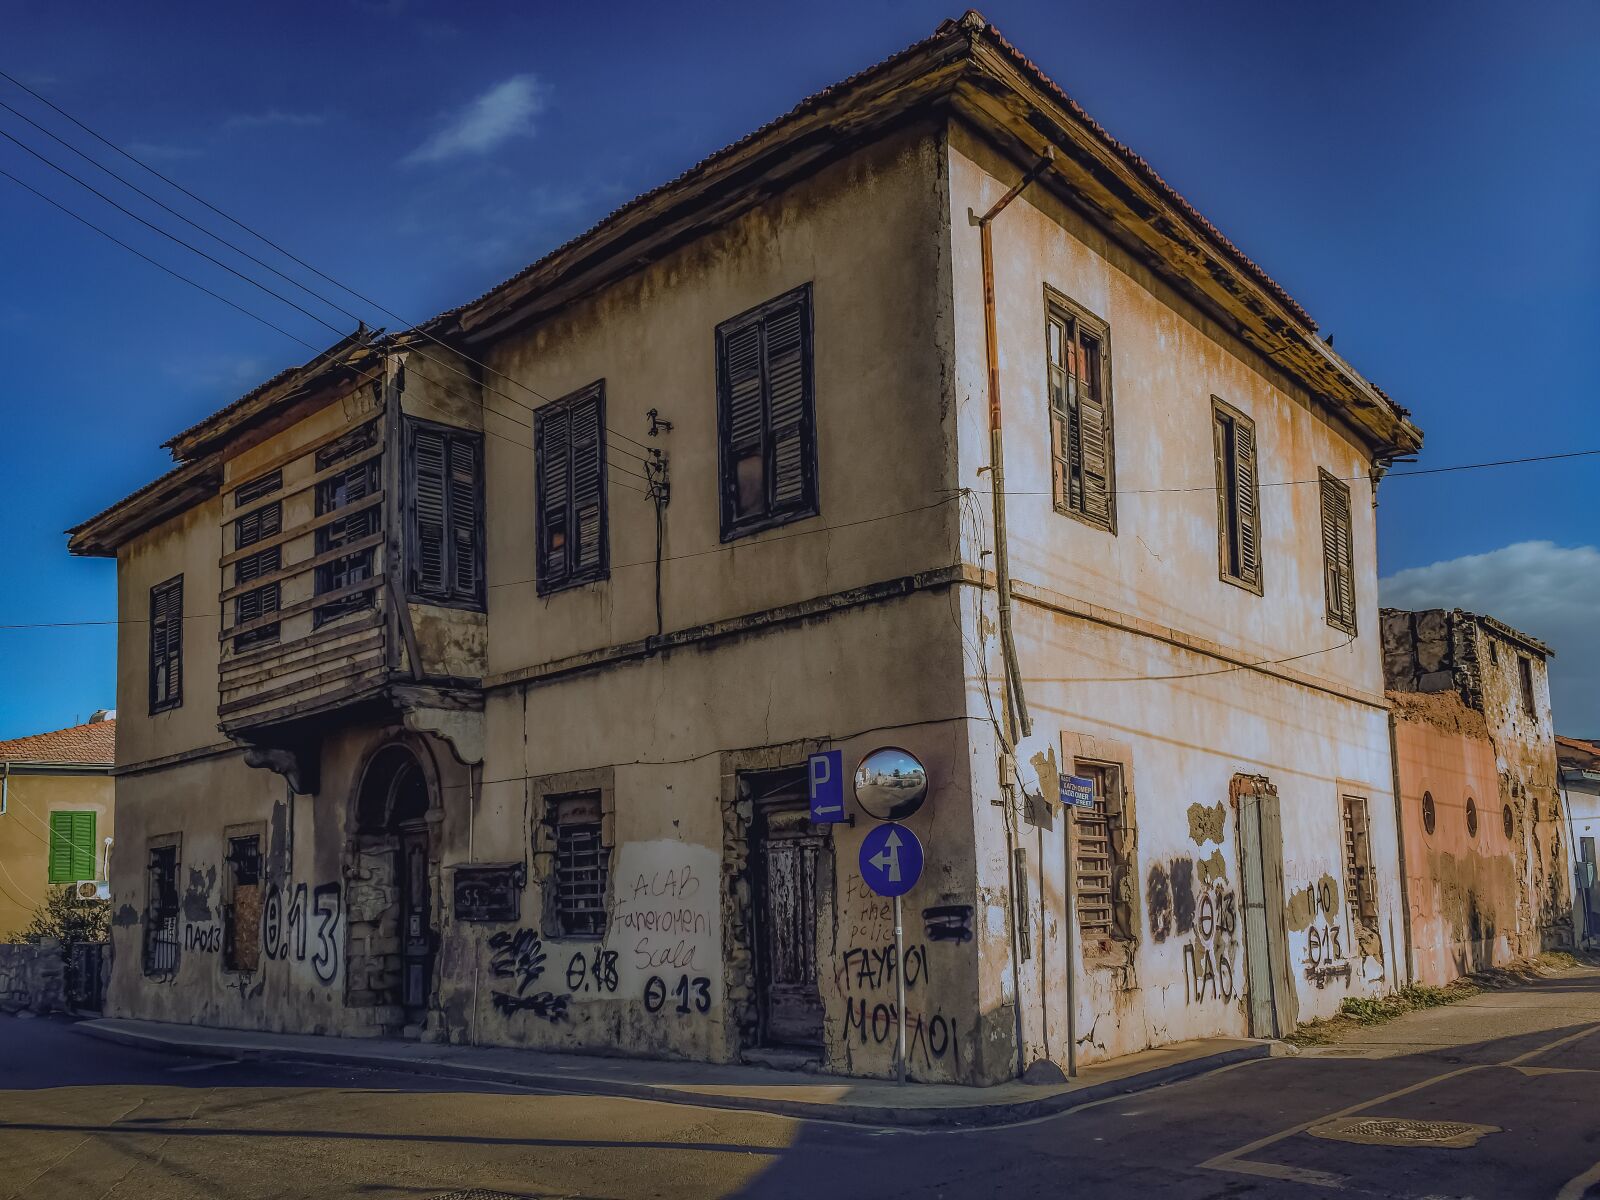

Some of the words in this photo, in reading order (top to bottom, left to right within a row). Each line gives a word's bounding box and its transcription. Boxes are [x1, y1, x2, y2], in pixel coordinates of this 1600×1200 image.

[810, 755, 831, 799] P
[1075, 791, 1089, 800] OMER
[633, 865, 699, 900] ACAB
